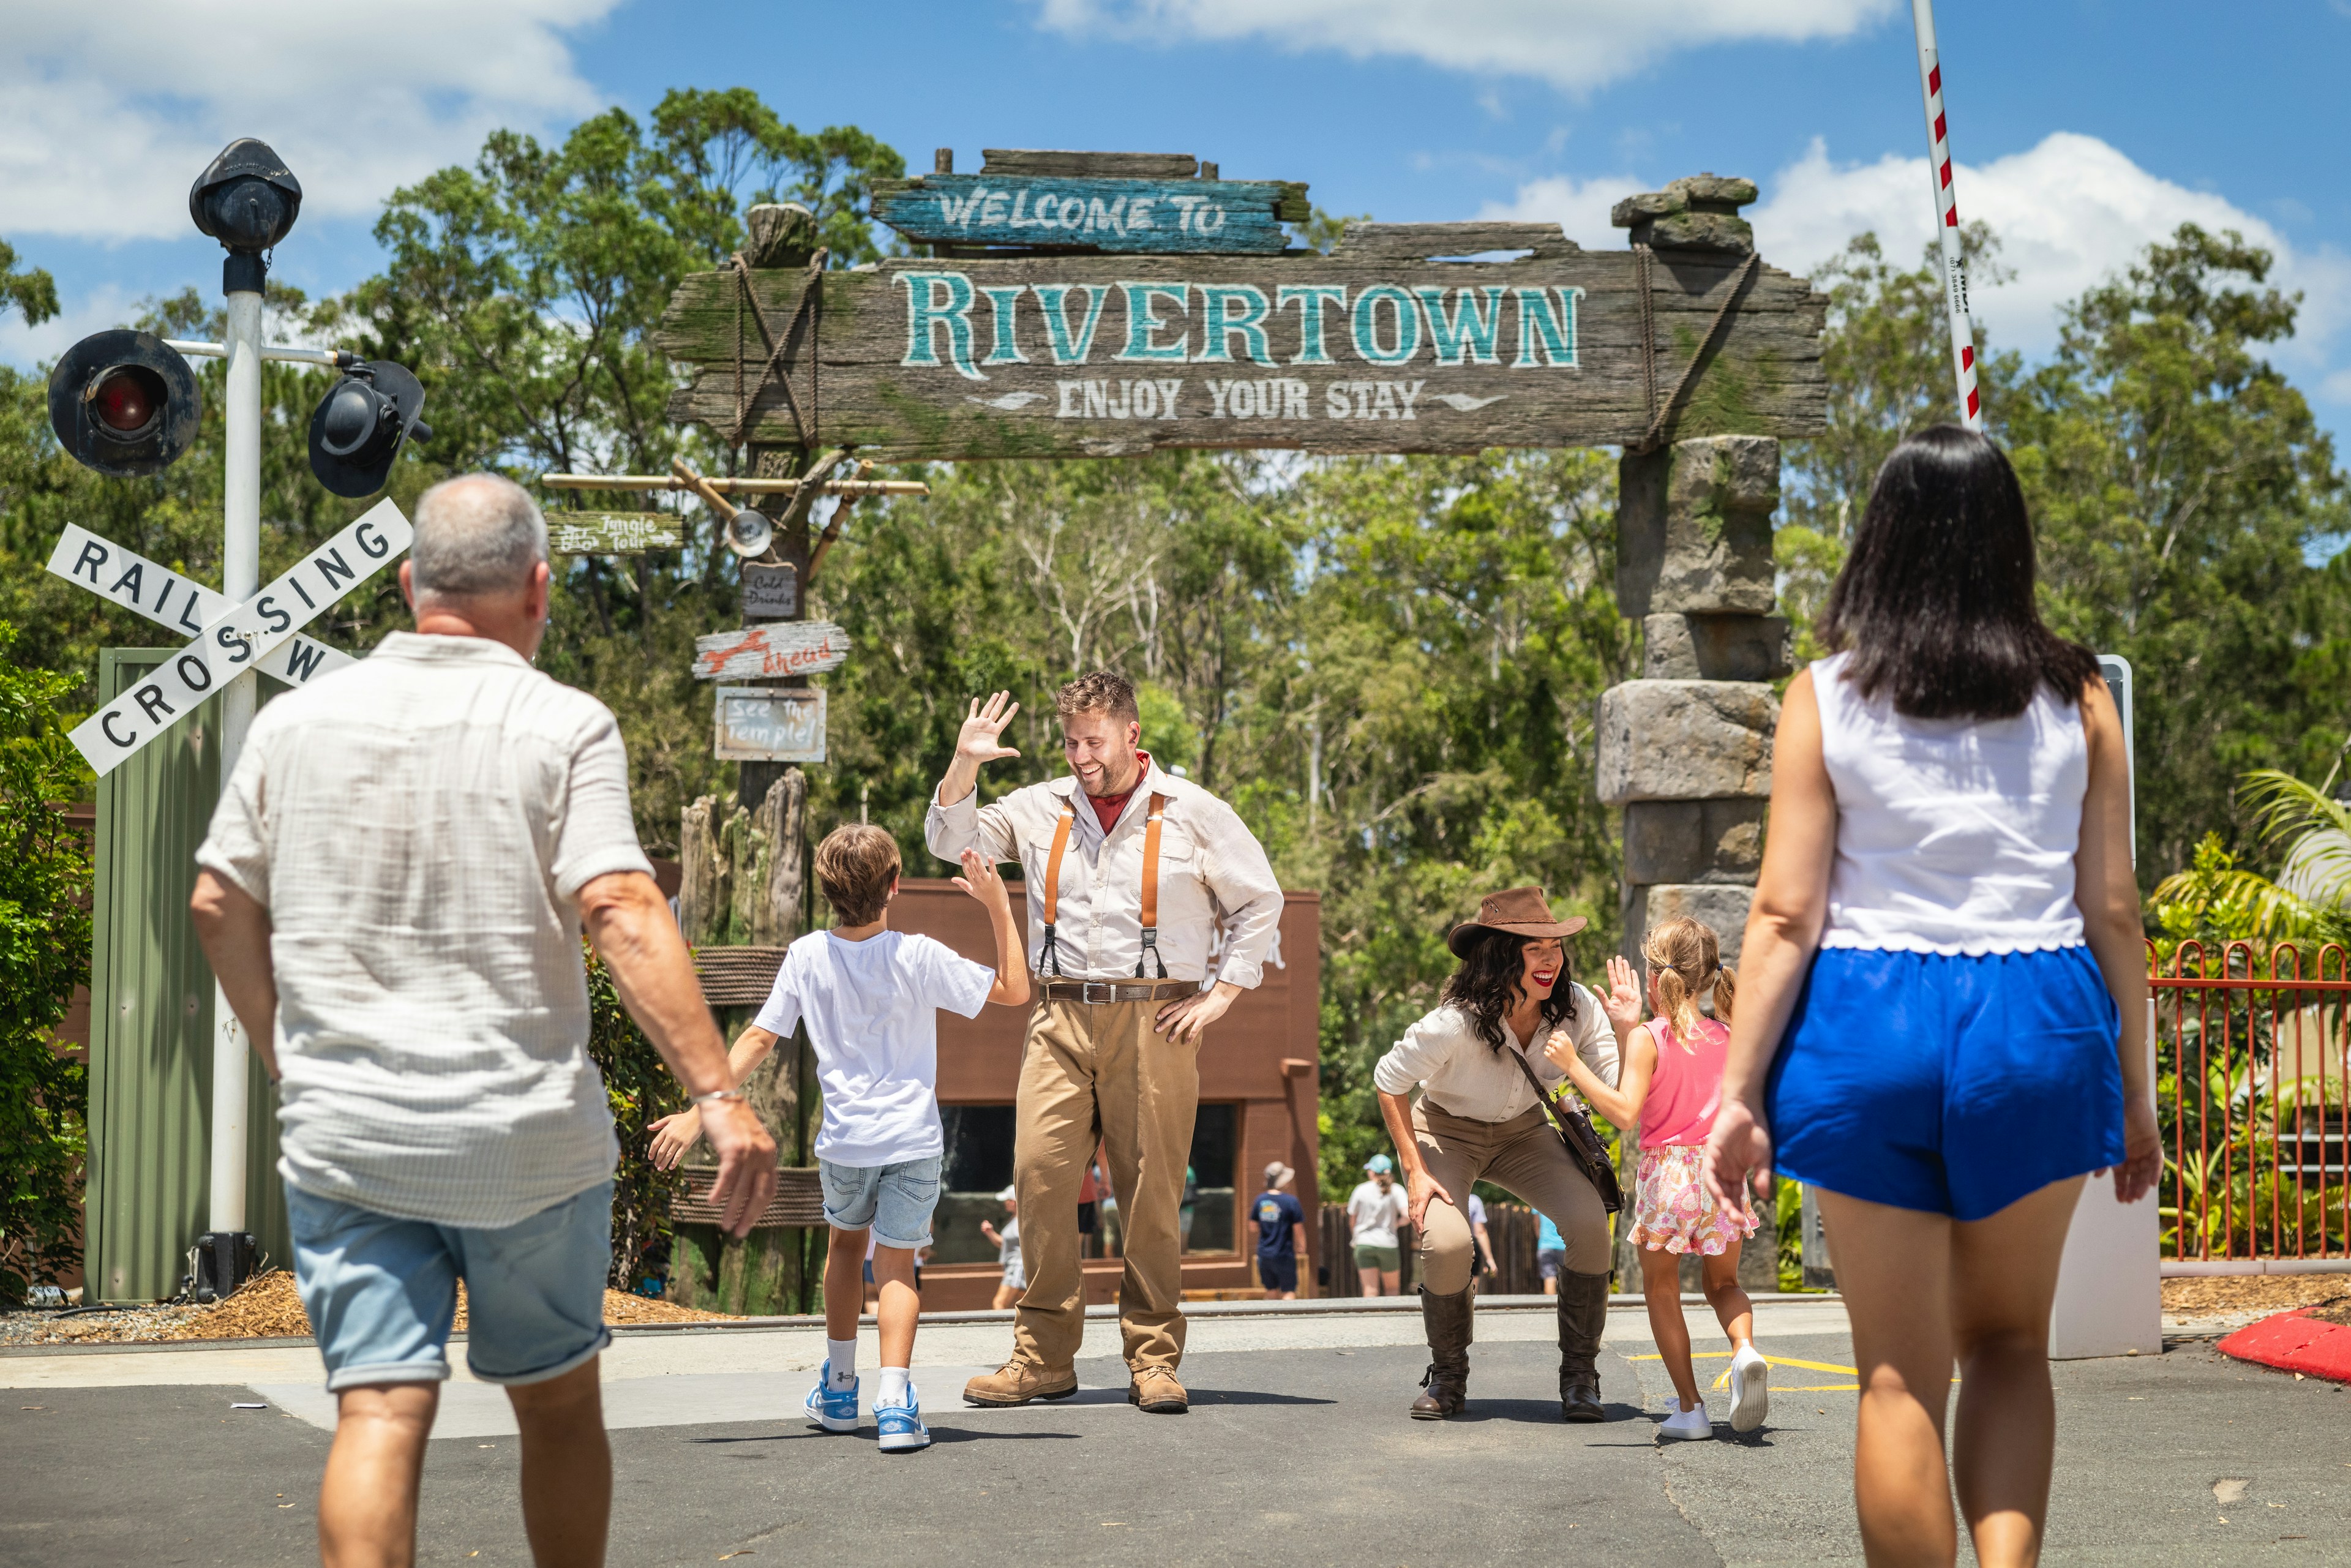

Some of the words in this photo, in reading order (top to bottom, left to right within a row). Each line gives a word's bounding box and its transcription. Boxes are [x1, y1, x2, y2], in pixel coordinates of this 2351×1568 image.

[935, 187, 1157, 238] WELCOME
[1169, 195, 1224, 236] TO
[891, 270, 1586, 381] RIVERTOWN
[1056, 378, 1183, 420] ENJOY
[1205, 377, 1311, 420] YOUR
[1325, 378, 1427, 421] STAY
[599, 515, 656, 536] Jungle
[608, 531, 648, 552] Tour
[749, 591, 791, 606] Drinks
[754, 576, 784, 590] Cold
[102, 523, 389, 748] CROSSING
[763, 636, 832, 674] Ahead
[730, 699, 771, 718] See
[726, 718, 817, 751] Temple!
